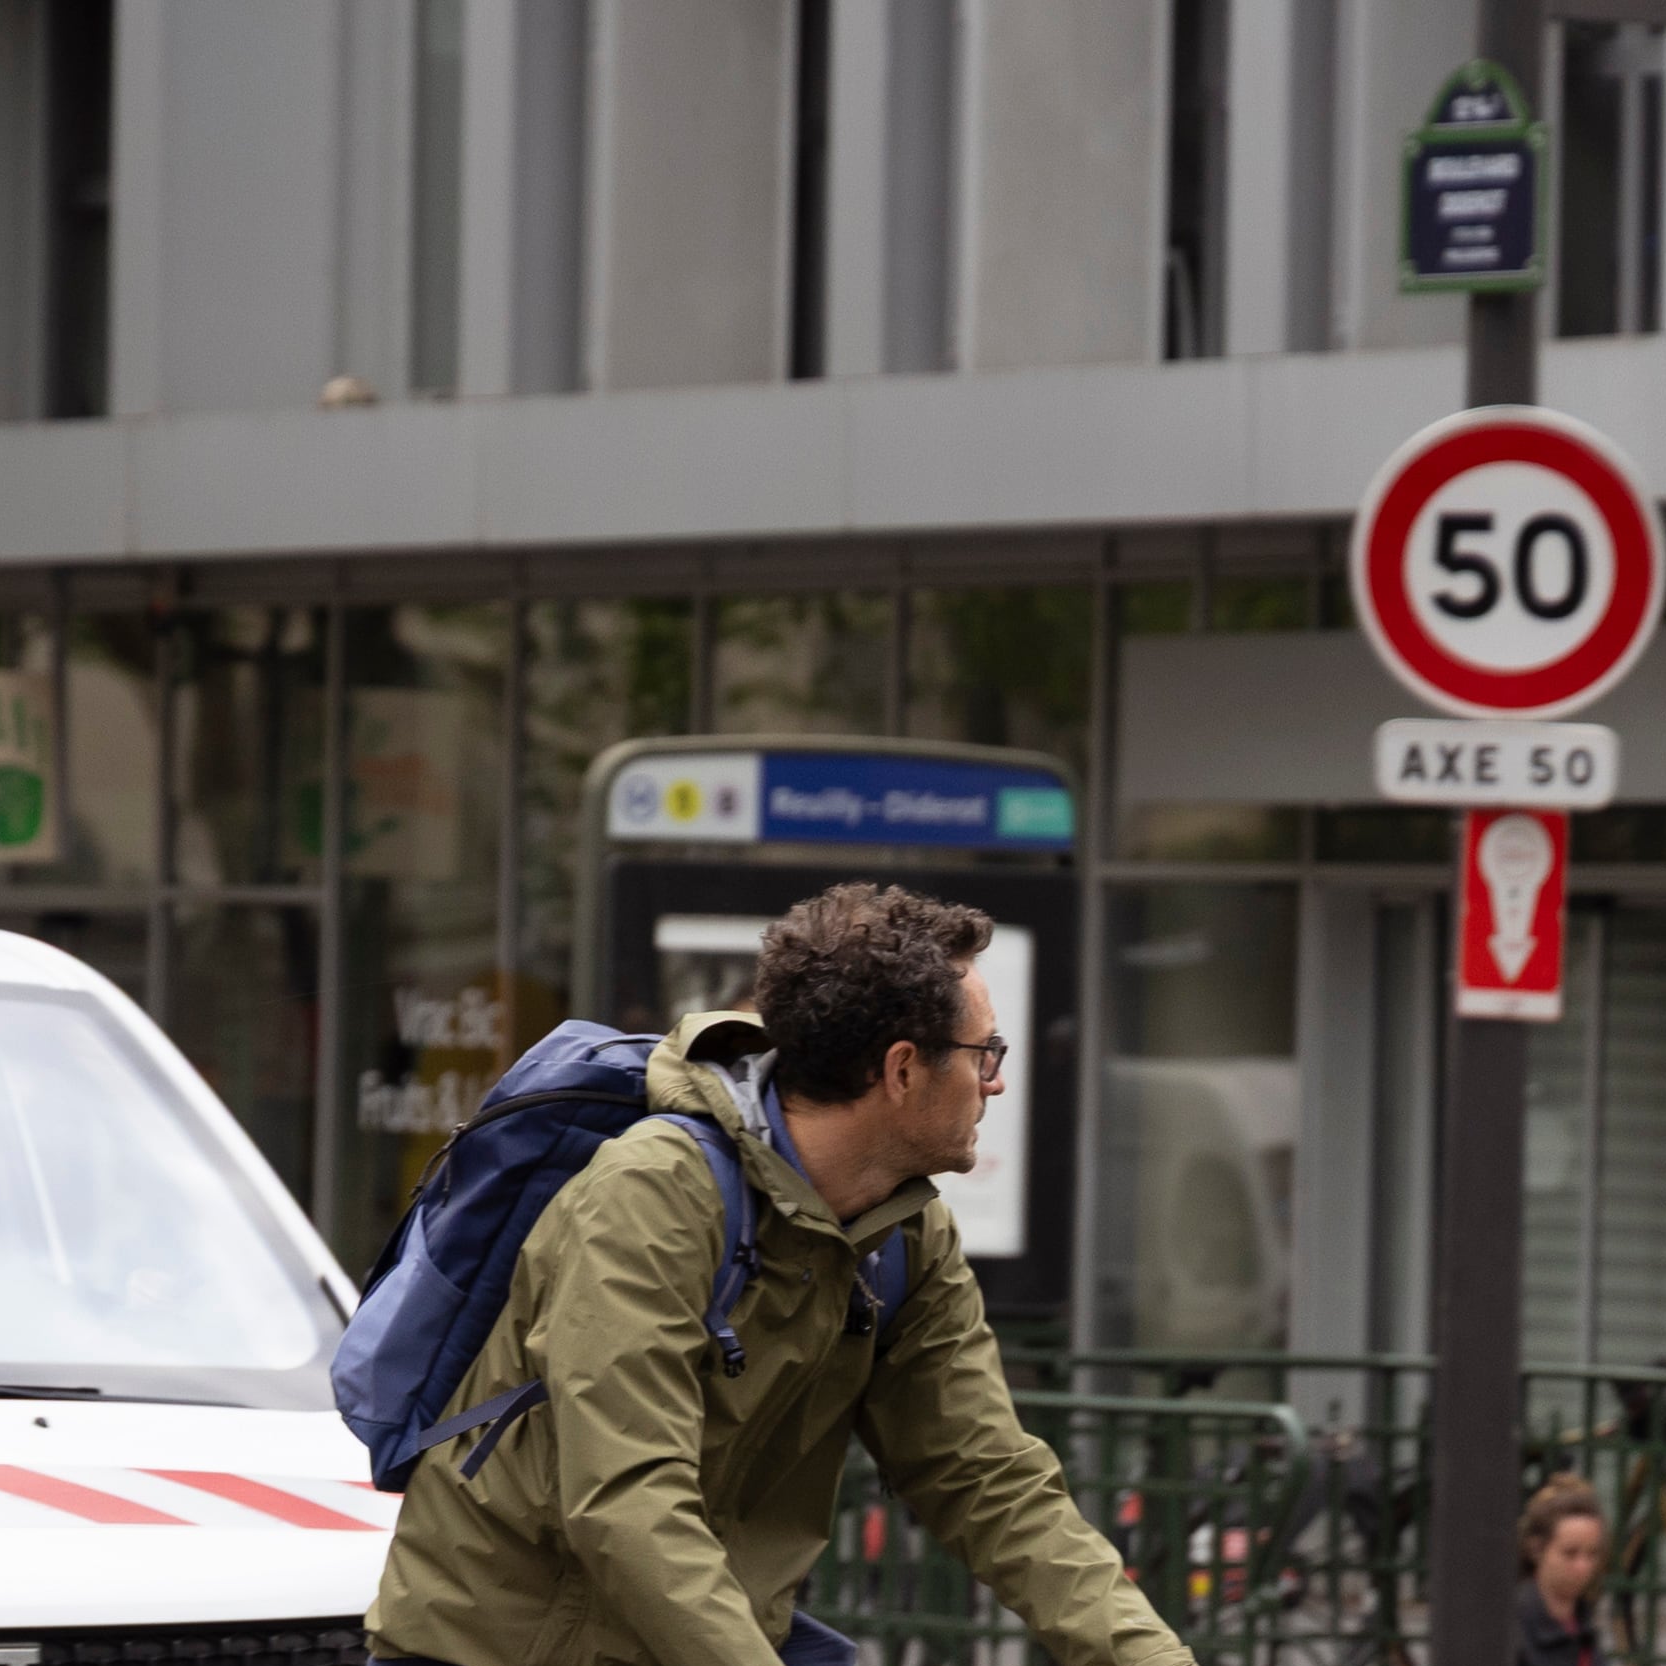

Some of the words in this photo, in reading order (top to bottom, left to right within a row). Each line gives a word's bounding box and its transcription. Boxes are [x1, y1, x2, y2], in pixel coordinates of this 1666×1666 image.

[1433, 512, 1589, 621] 50
[1399, 743, 1500, 784] AXE
[1529, 745, 1594, 787] 50
